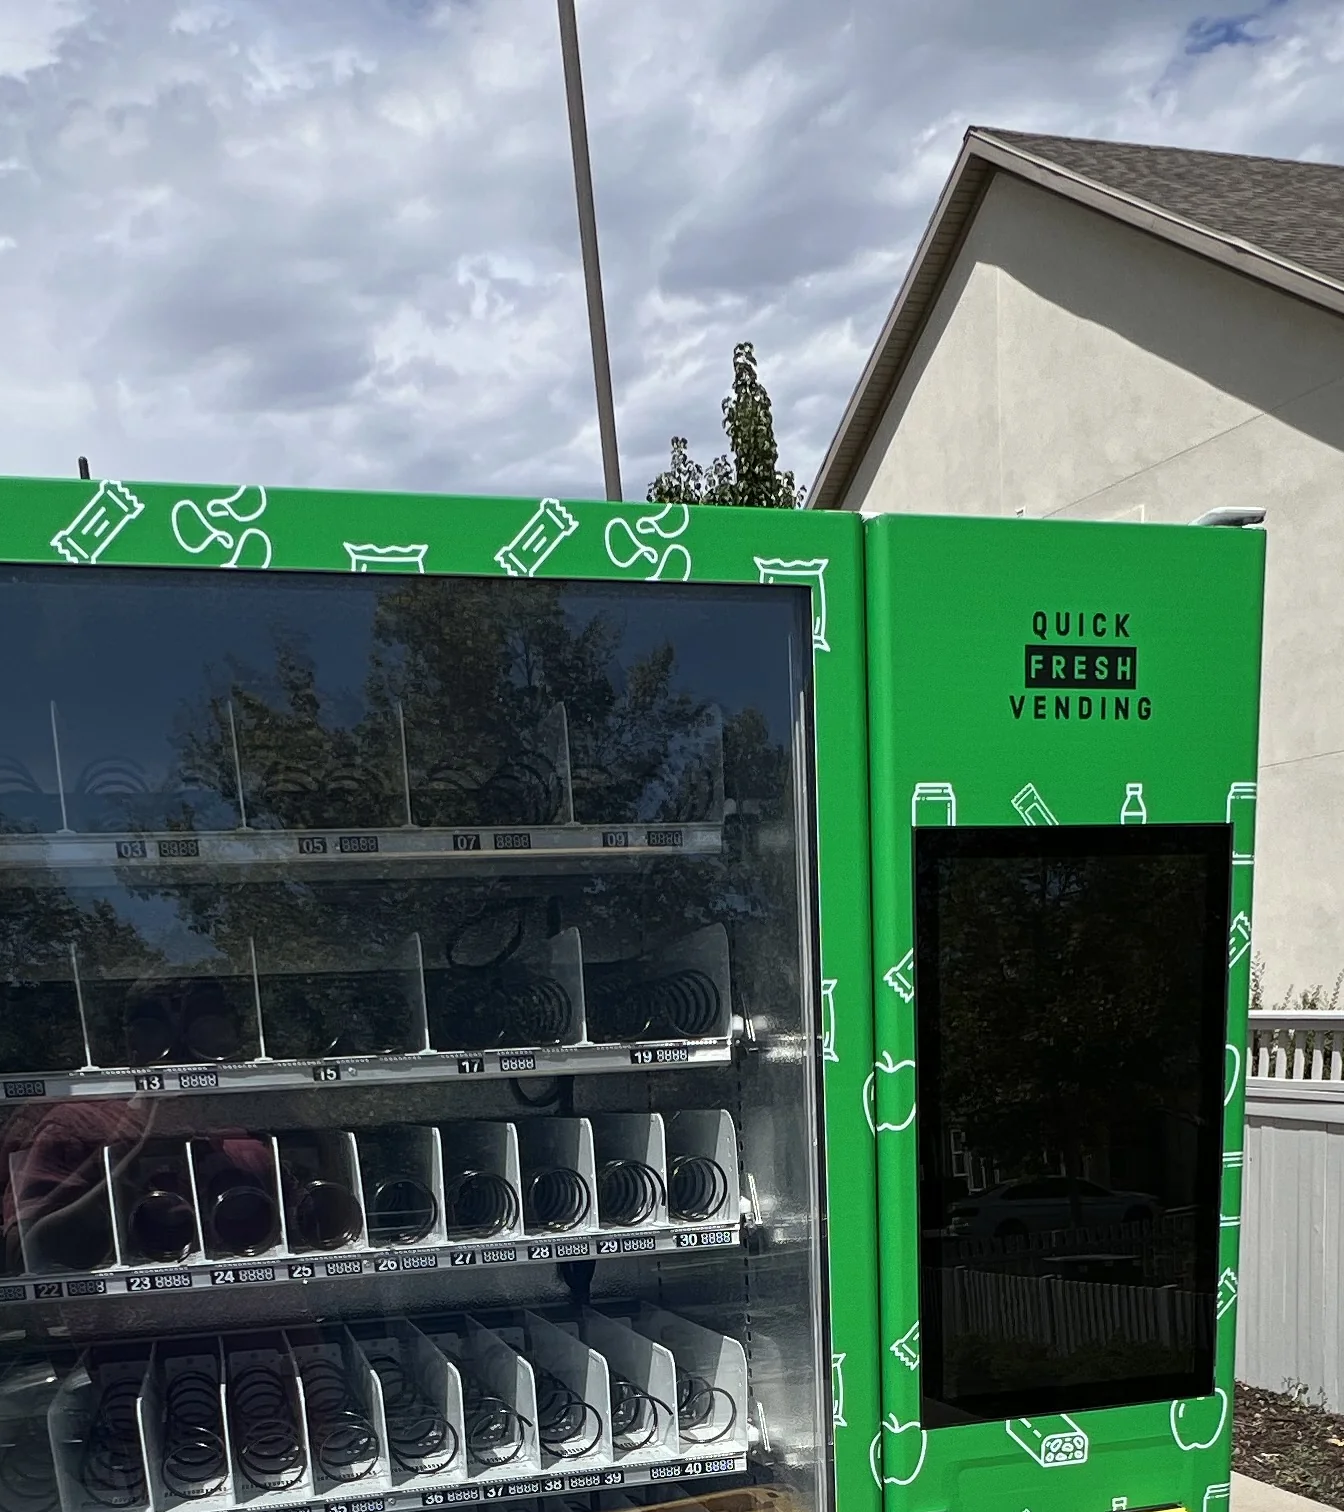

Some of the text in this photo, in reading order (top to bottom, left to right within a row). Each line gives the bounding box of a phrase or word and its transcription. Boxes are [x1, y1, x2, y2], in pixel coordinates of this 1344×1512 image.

[1033, 611, 1130, 640] QUICK
[1030, 655, 1131, 680] FRESH
[1009, 695, 1151, 720] VENDING
[120, 842, 145, 858] 03
[303, 838, 325, 853] 05
[457, 835, 477, 850] 07
[607, 833, 627, 847] 09
[138, 1077, 160, 1091] 13
[317, 1067, 337, 1081] 15
[462, 1059, 480, 1073] 17
[634, 1050, 653, 1063] 19
[38, 1283, 61, 1298] 22
[130, 1276, 151, 1291] 23
[214, 1270, 235, 1284] 24
[292, 1264, 312, 1279] 25
[378, 1257, 398, 1271] 26
[454, 1253, 473, 1265] 27
[531, 1245, 550, 1259] 28
[599, 1240, 619, 1253] 29
[679, 1233, 699, 1247] 30
[424, 1492, 444, 1506] 36
[487, 1486, 504, 1498] 37
[544, 1478, 562, 1491] 38
[604, 1471, 622, 1484] 39
[684, 1462, 702, 1475] 40
